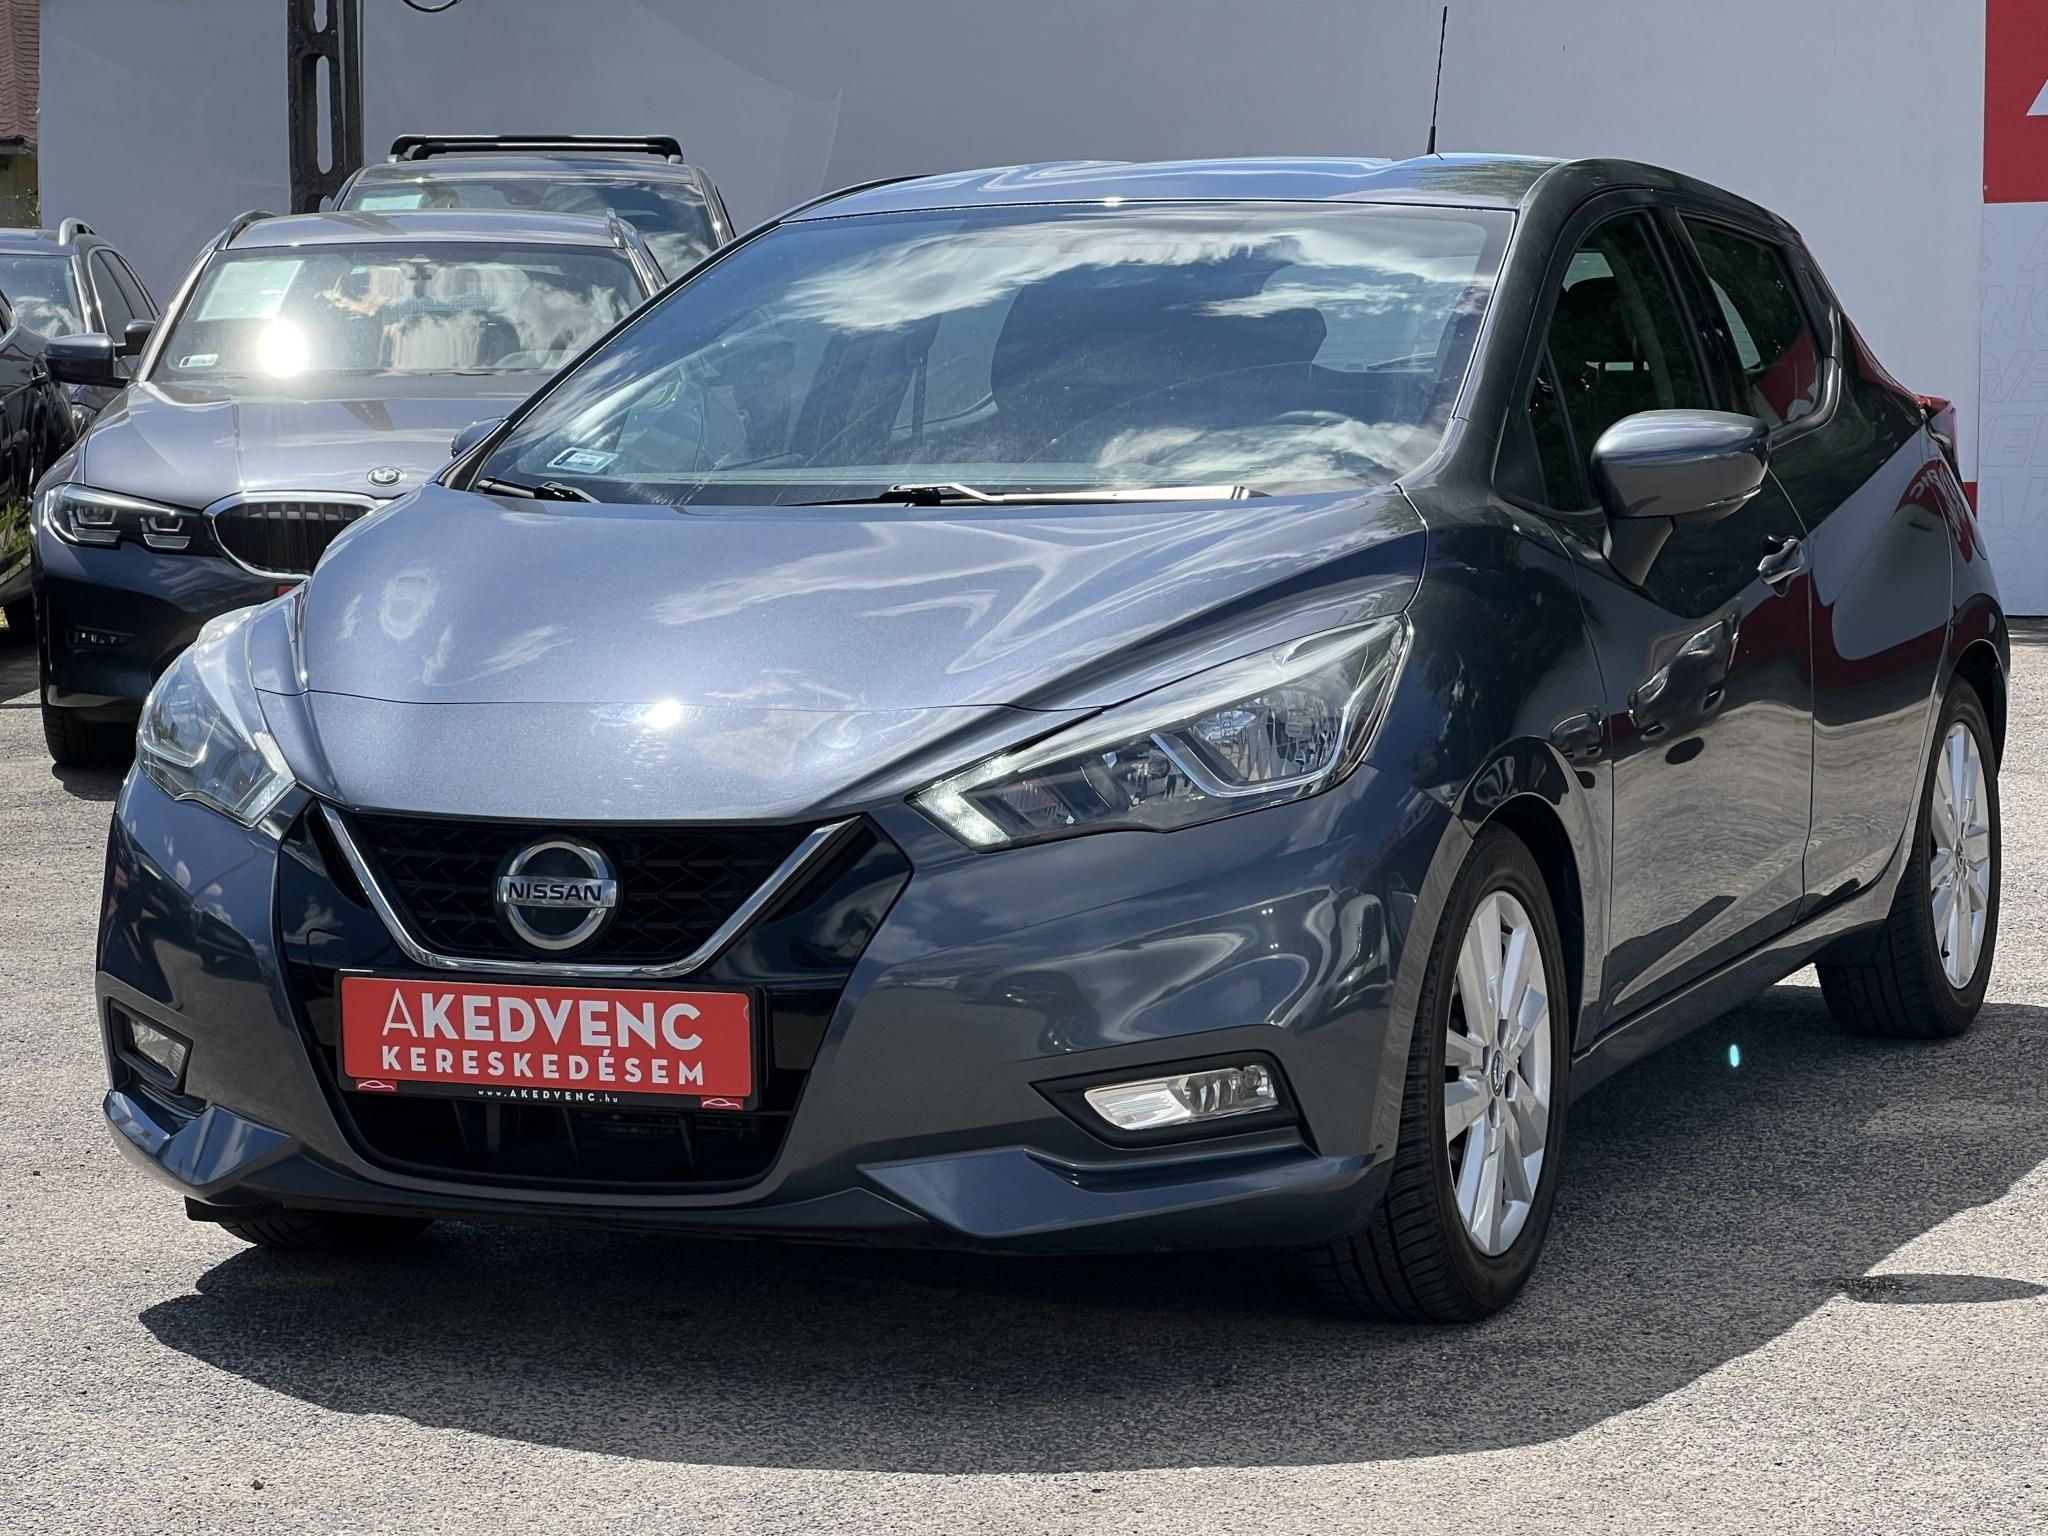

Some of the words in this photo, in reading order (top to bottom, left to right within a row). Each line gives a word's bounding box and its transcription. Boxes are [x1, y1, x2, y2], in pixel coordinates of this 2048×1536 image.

[508, 882, 602, 902] NISSAN
[381, 1045, 705, 1086] KERESKEDÉSEM
[477, 1088, 619, 1104] www.AKEDVENC.hu
